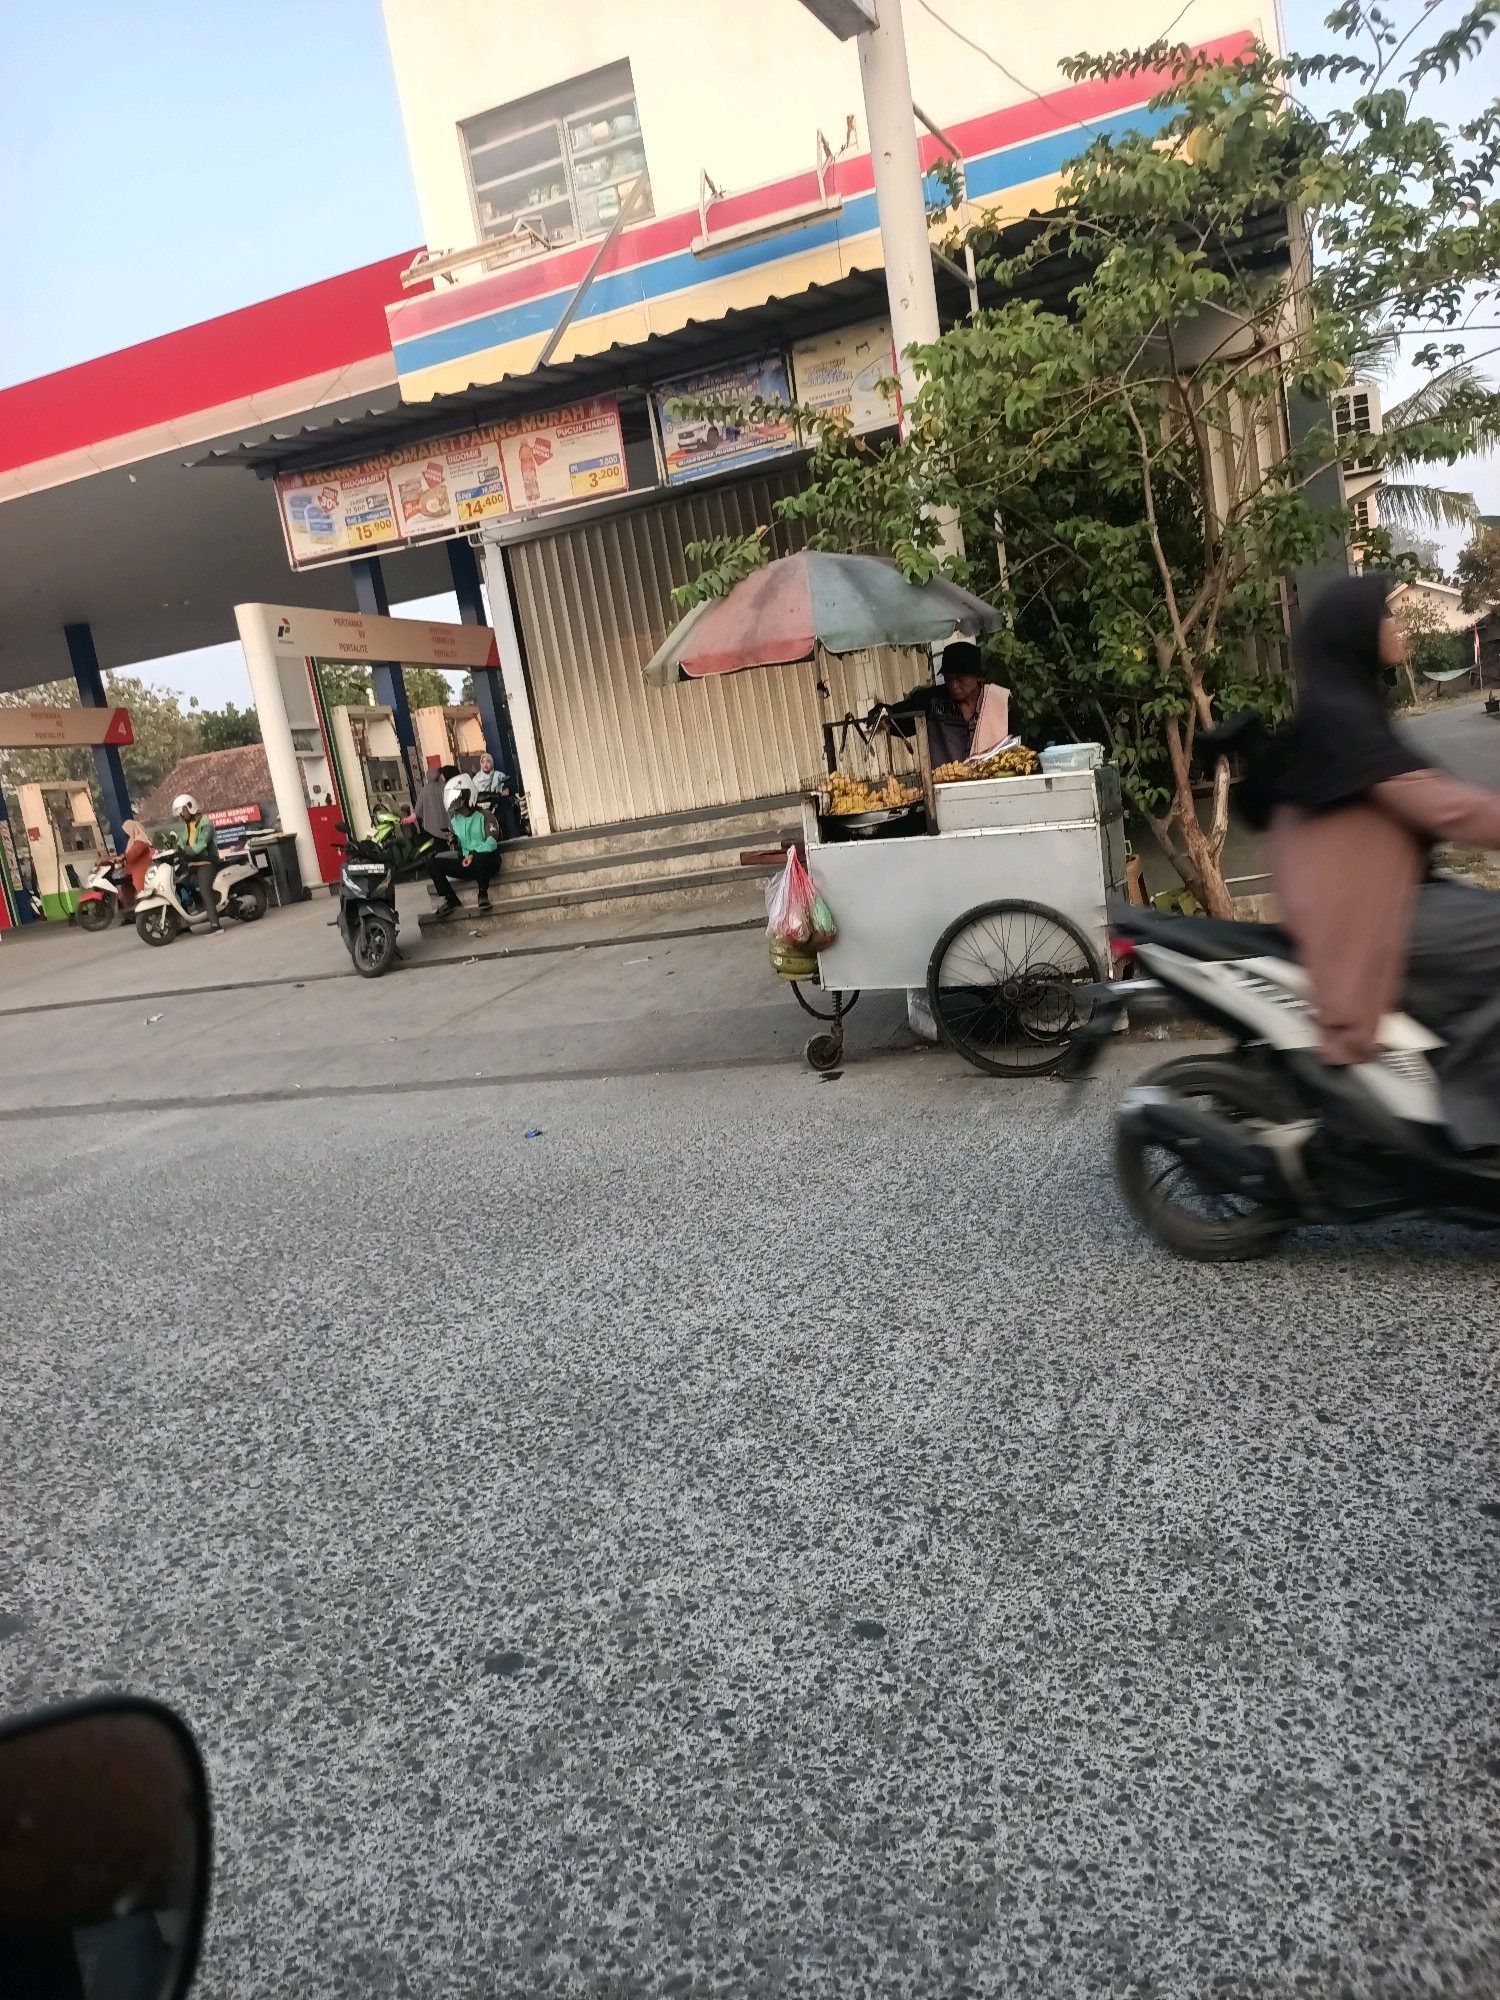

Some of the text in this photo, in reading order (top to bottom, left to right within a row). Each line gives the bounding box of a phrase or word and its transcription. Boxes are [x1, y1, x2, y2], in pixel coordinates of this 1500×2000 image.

[556, 416, 616, 438] PUCUK HARUM
[303, 464, 361, 485] PROMO
[363, 440, 456, 472] INDOMARET
[460, 422, 519, 449] PALING
[521, 405, 585, 433] MURAH
[447, 449, 480, 463] INDOMIE
[341, 473, 384, 489] INDOMARET
[588, 466, 620, 487] 3.200
[465, 494, 504, 517] 14.400
[356, 518, 392, 541] 15.900
[333, 617, 363, 627] PERTAMAX
[338, 643, 368, 653] PERTALITE
[117, 721, 127, 736] 4
